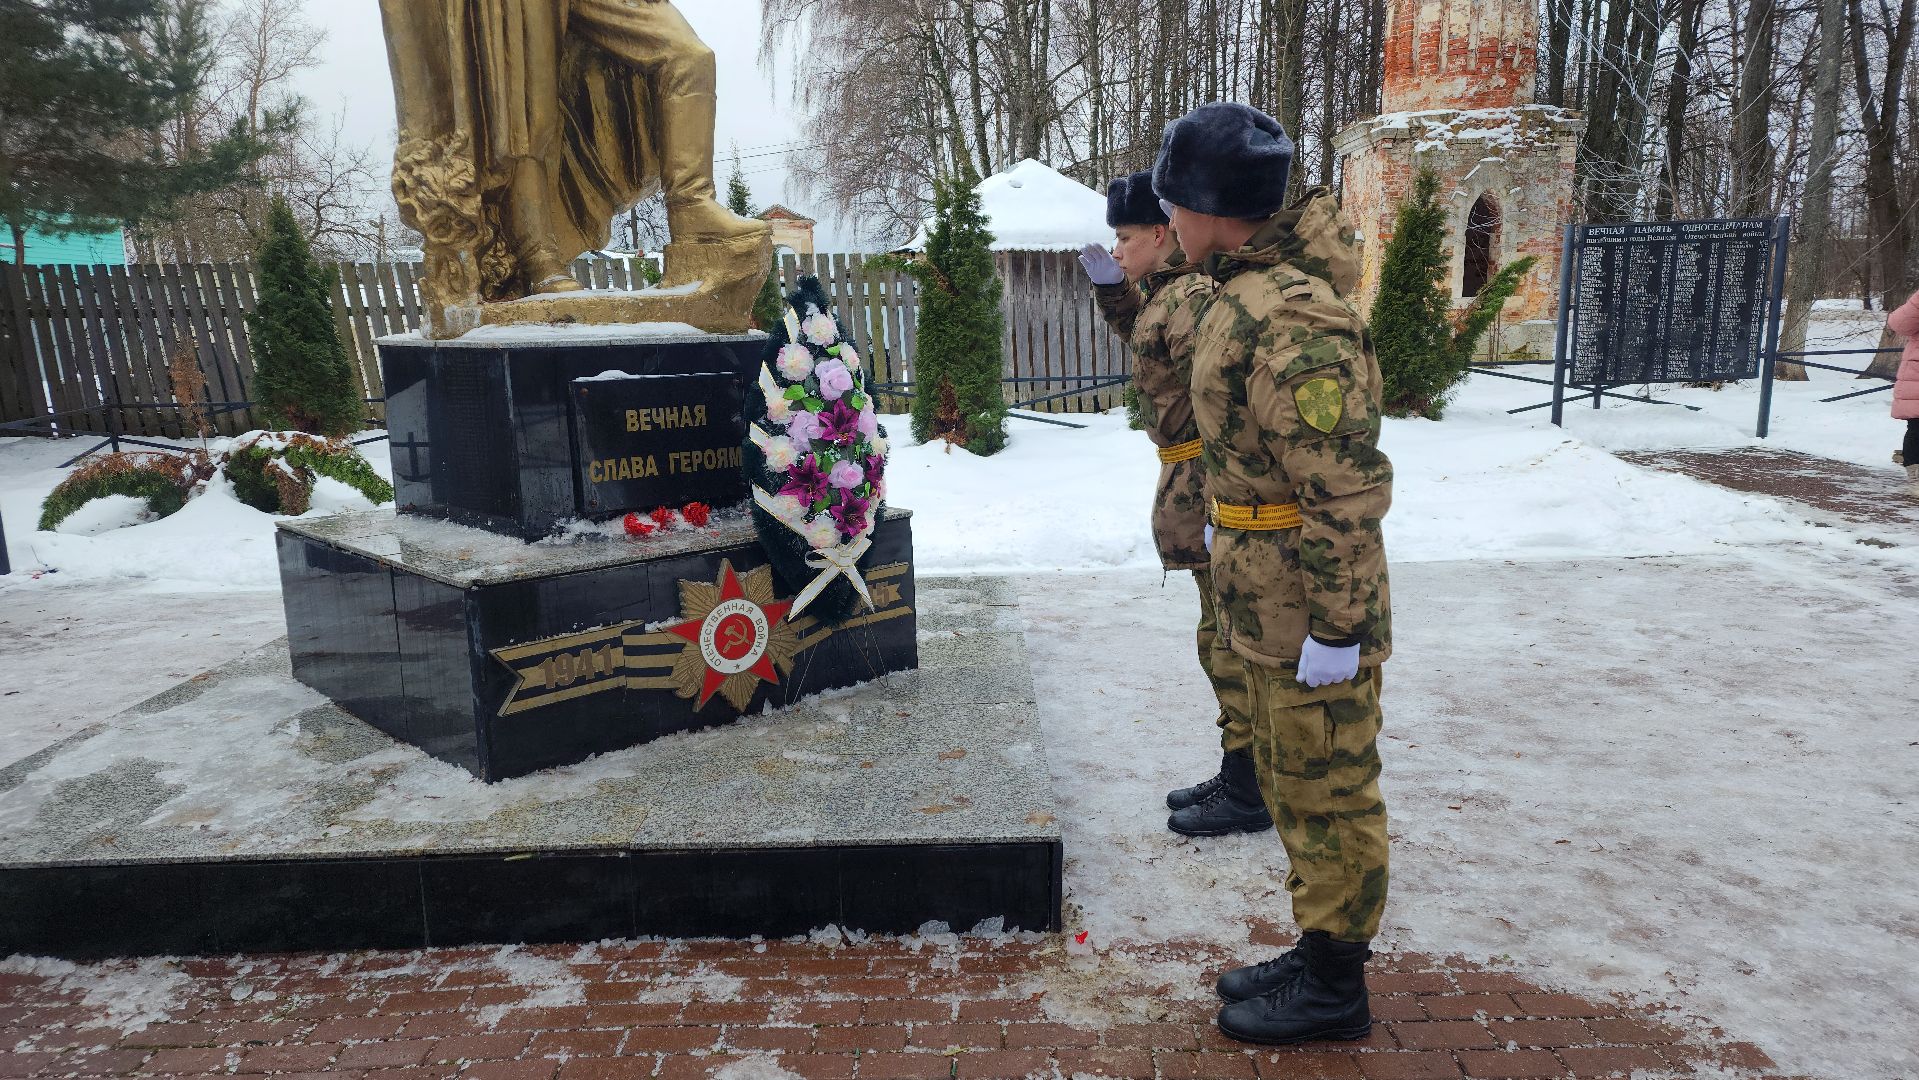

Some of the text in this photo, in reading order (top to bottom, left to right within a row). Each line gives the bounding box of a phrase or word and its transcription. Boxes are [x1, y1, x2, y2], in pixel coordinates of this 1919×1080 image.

[1588, 221, 1763, 236] ВЕЧНАЯ ПАМЯТЬ ОДНОСЕЛЬЧАНАМ
[625, 404, 707, 432] ВЕЧНАЯ
[589, 446, 743, 483] СЛАВА ГЕРОЯМ
[703, 602, 766, 667] ОТЕЧЕСТВЕННАЯ ВОЙНА
[538, 643, 614, 689] 1941
